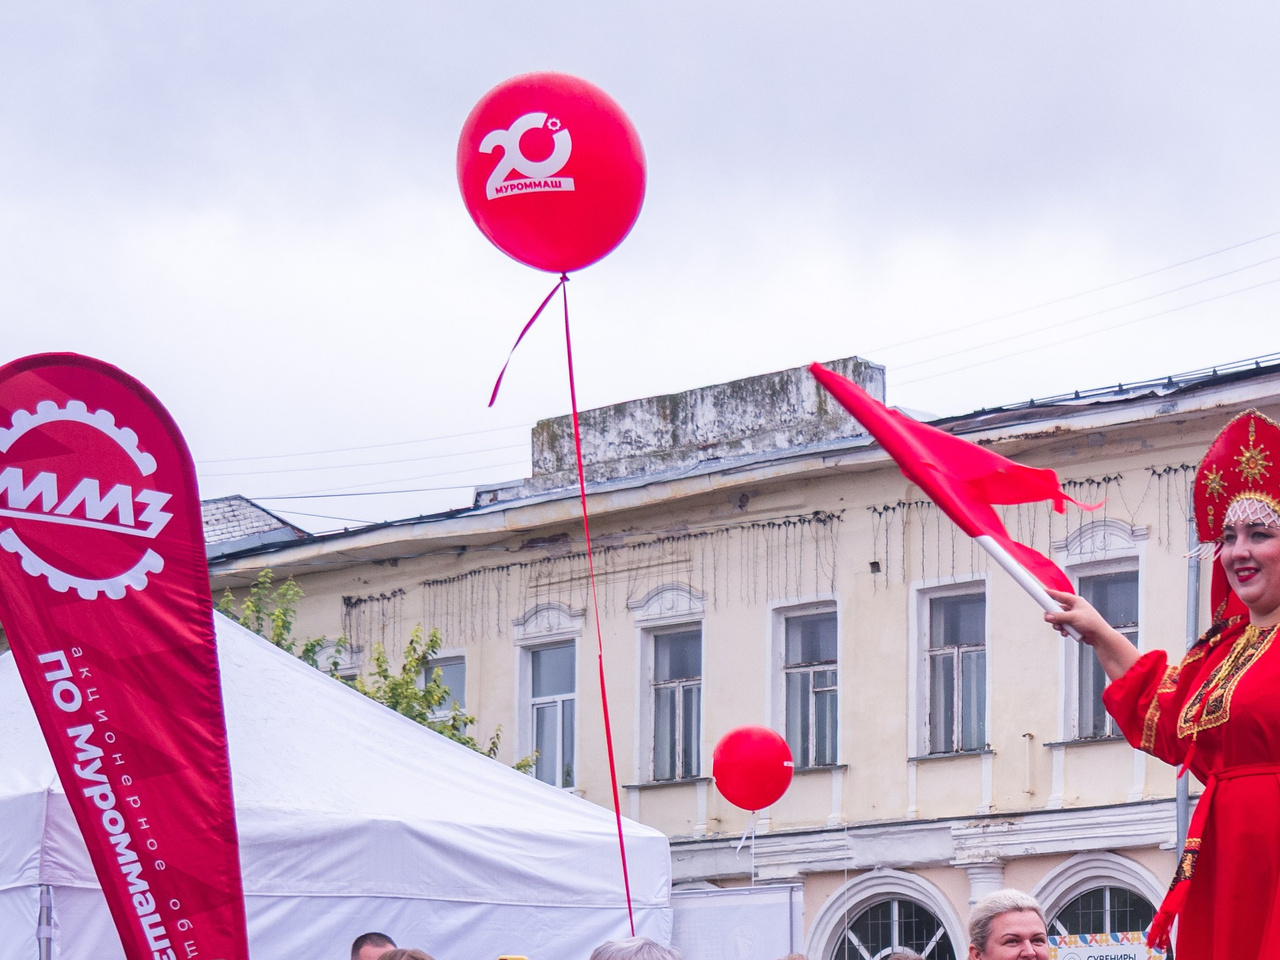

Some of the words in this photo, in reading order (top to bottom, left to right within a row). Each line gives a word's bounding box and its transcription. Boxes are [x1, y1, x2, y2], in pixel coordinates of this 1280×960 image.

[495, 180, 562, 195] МУРОММАШ
[38, 649, 83, 713] ПО
[71, 645, 166, 872] акционерное
[169, 897, 199, 959] общ
